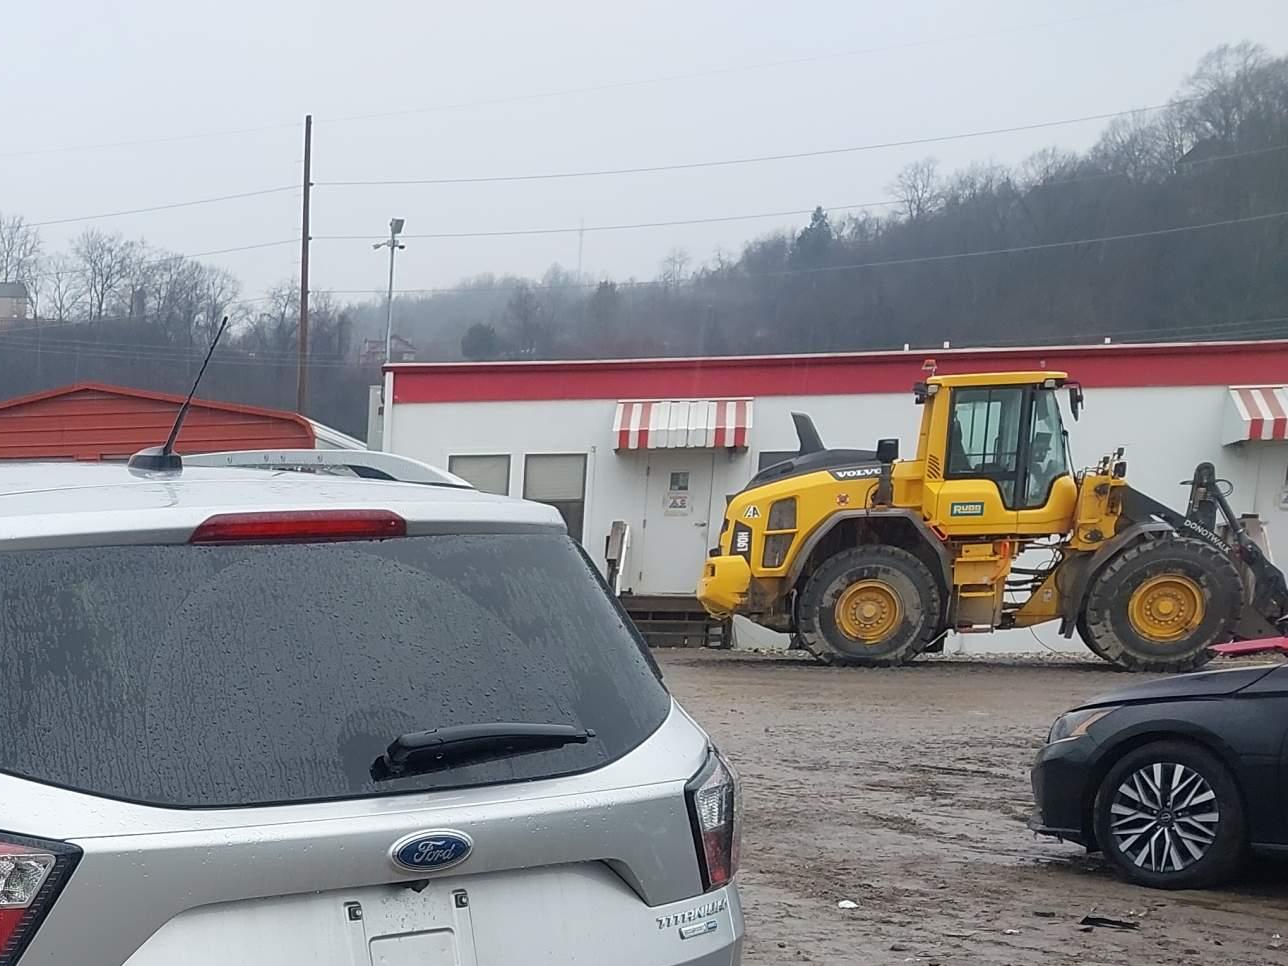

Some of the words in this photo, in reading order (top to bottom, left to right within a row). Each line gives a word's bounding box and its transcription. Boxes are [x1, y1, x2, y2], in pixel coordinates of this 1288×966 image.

[836, 468, 882, 478] VOLVO
[737, 531, 749, 551] L90H
[414, 840, 456, 863] Ford
[656, 897, 728, 930] TITANIUM
